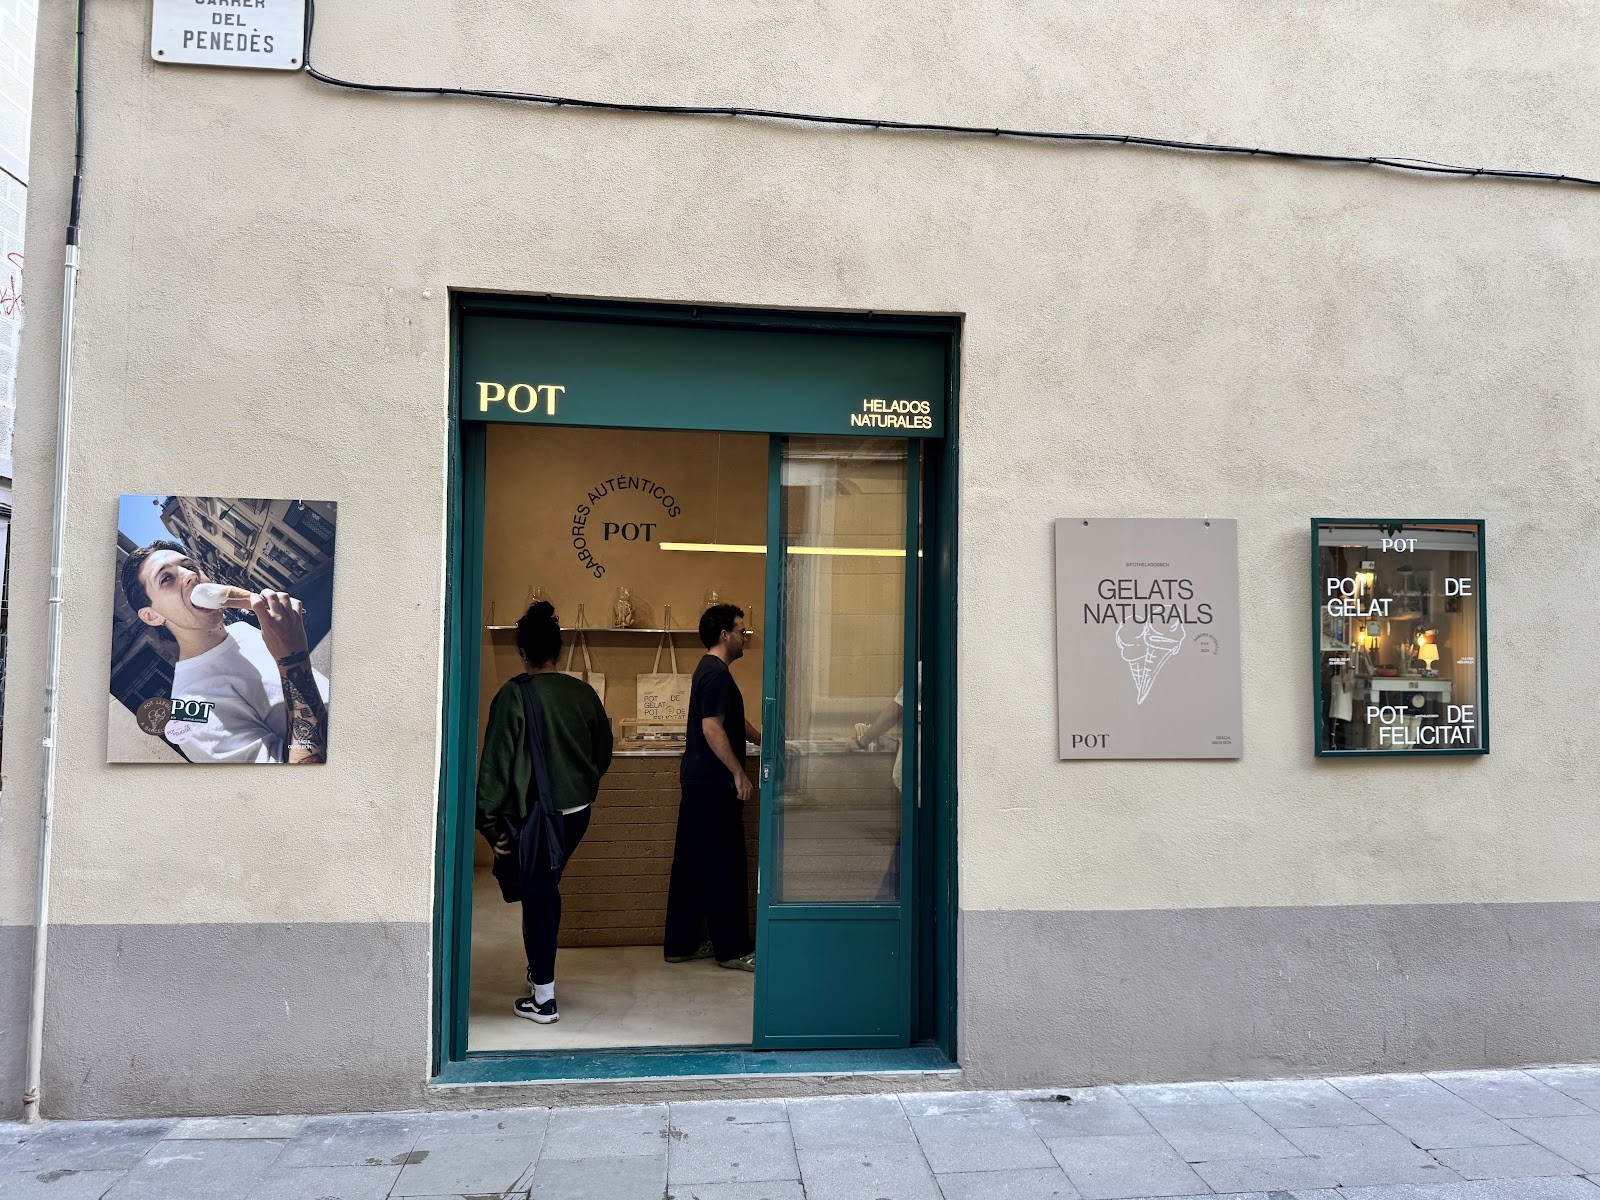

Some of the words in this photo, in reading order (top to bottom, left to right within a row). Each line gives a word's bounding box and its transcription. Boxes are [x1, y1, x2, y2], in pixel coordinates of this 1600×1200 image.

[212, 12, 247, 27] DEL
[183, 28, 274, 54] PENEDÈS
[475, 382, 566, 415] POT
[863, 399, 930, 414] HELADOS
[851, 414, 932, 429] NATURALES
[587, 474, 681, 518] AUTÉNTICOS
[572, 504, 606, 579] SABORES
[603, 522, 657, 542] POT
[1381, 538, 1417, 553] POT
[1097, 579, 1194, 600] GELATS
[1326, 577, 1368, 597] POT
[1444, 577, 1473, 597] DE
[1083, 603, 1213, 624] NATURALS
[1327, 598, 1393, 617] GELAT
[171, 699, 215, 719] POT
[1366, 705, 1409, 725] POT
[1447, 704, 1475, 724] DE
[1071, 733, 1110, 748] POT
[1379, 725, 1476, 745] FELICITAT
